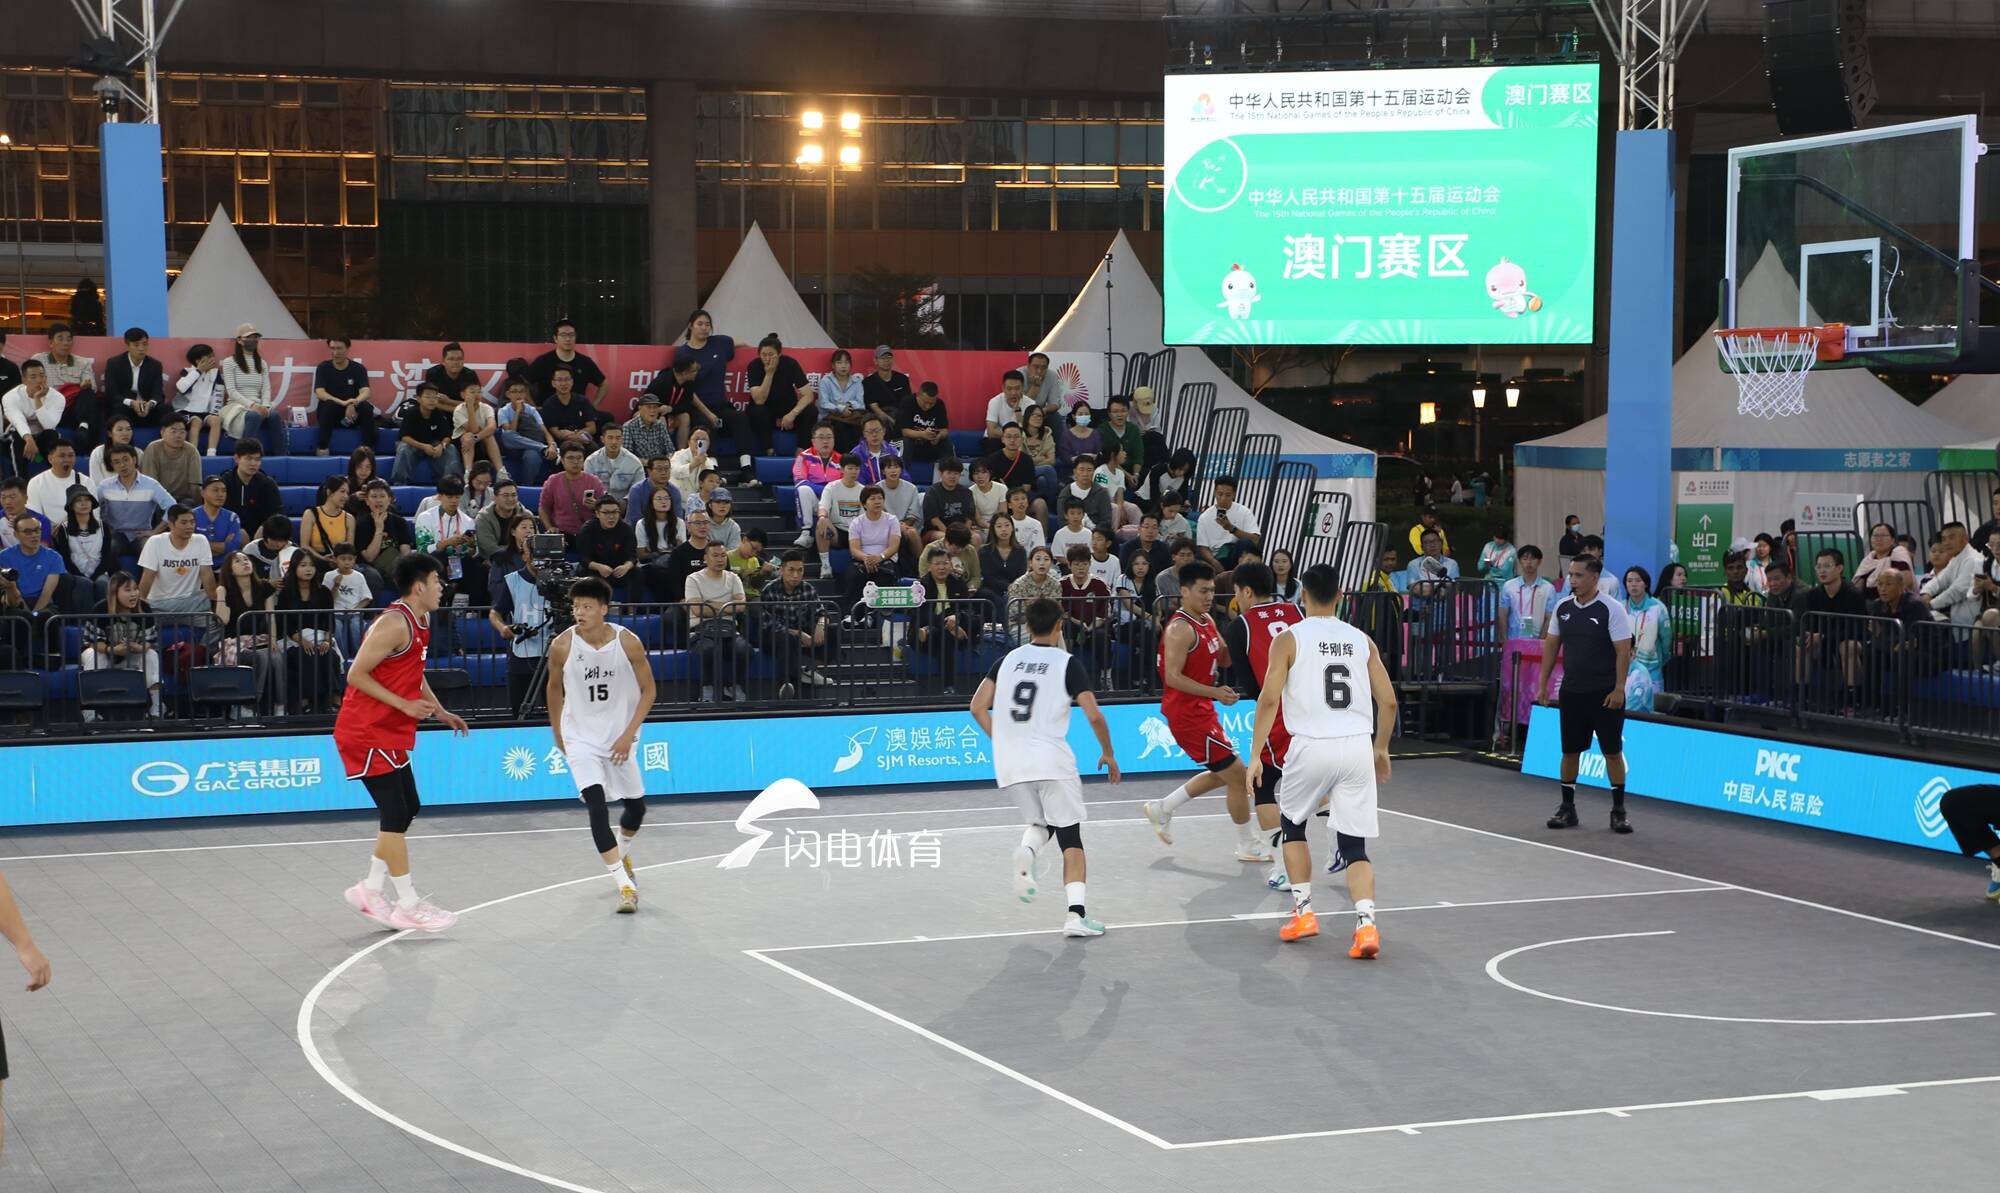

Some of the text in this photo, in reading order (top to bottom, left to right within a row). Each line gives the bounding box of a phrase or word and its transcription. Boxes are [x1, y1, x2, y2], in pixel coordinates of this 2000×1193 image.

[1229, 87, 1471, 109] 中华人民共和国第十五届运动会
[1505, 83, 1592, 106] 澳门赛区
[1267, 112, 1300, 120] National
[1344, 110, 1358, 118] the
[1360, 109, 1395, 118] People's
[1397, 108, 1433, 118] Republic
[1435, 108, 1444, 116] of
[1447, 107, 1470, 115] China
[1248, 186, 1501, 207] 中华人民共和国第十五届运动会
[1283, 232, 1470, 281] 澳门赛区
[1844, 451, 1912, 468] 志愿者之家
[1692, 531, 1718, 547] 出口
[163, 559, 180, 568] JUST
[180, 559, 191, 567] DO
[1318, 641, 1354, 657] 华刚辉
[588, 684, 609, 702] 15
[1323, 663, 1353, 711] 6
[1011, 681, 1038, 722] 9
[885, 724, 980, 752] 澳娛綜合
[194, 757, 321, 780] 广汽集团
[877, 751, 991, 771] SJM Resorts, S.A.
[1754, 748, 1801, 782] PICC
[194, 776, 322, 792] GAC GROUP
[1722, 779, 1824, 816] 中国人民保险
